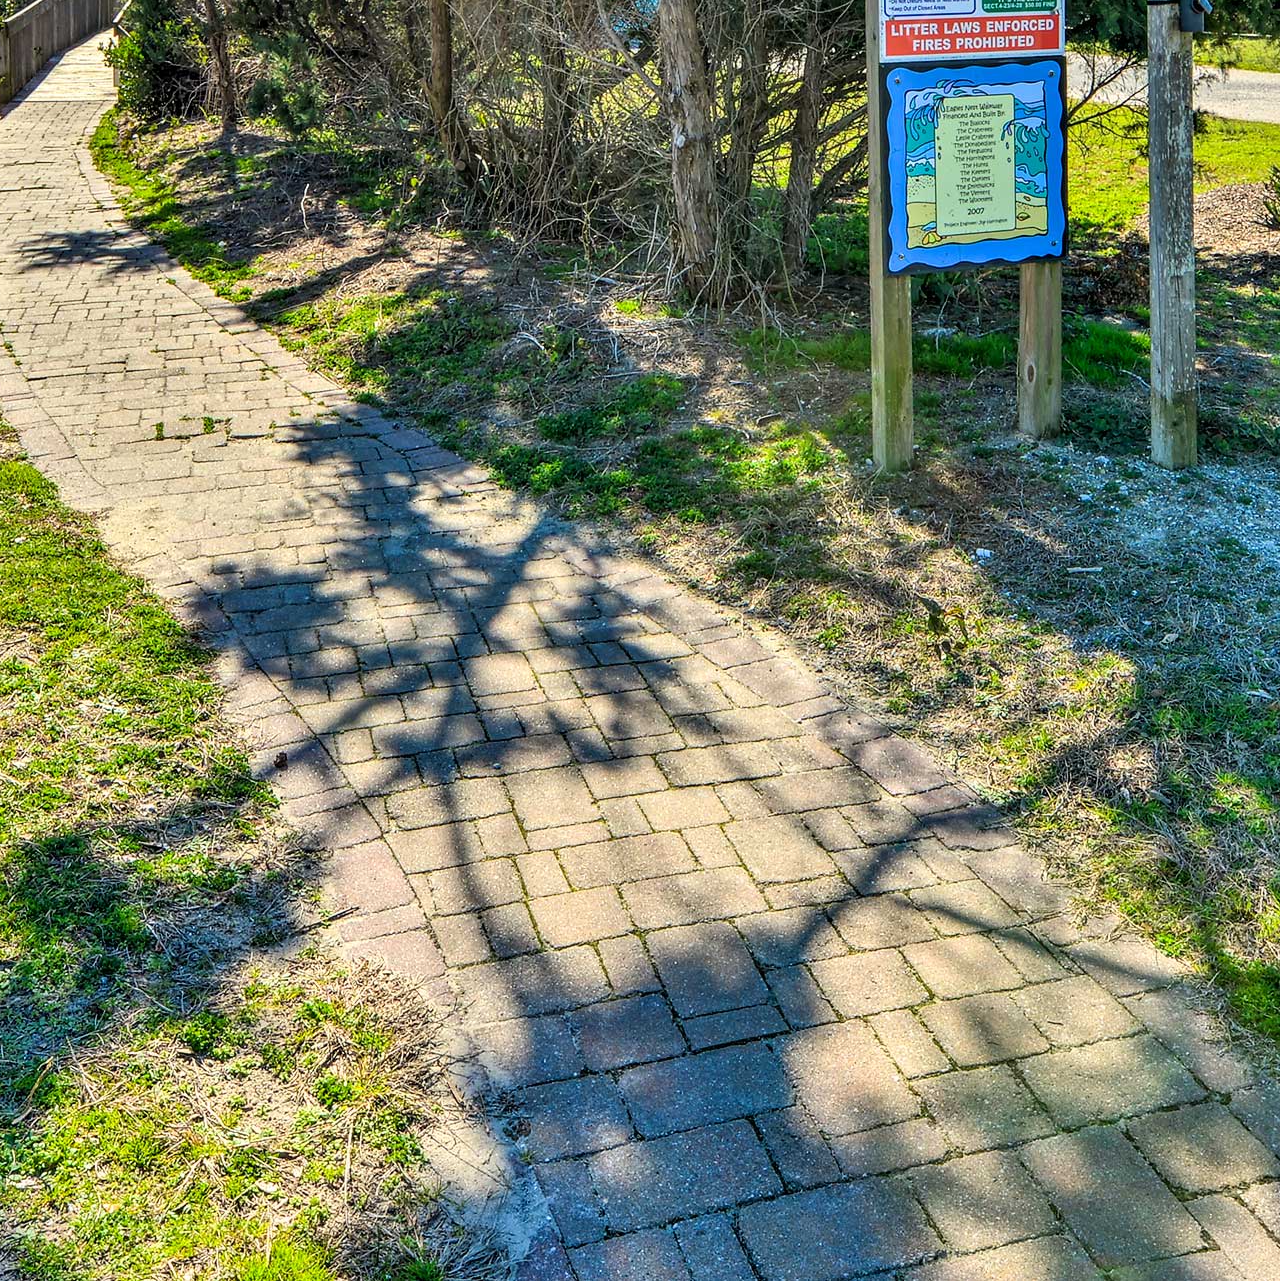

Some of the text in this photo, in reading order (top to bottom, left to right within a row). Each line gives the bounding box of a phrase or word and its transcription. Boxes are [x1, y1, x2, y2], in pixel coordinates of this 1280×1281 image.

[891, 20, 1054, 36] LITTER LAWS ENFORCED
[913, 36, 1034, 51] FIRES PROHIBITED
